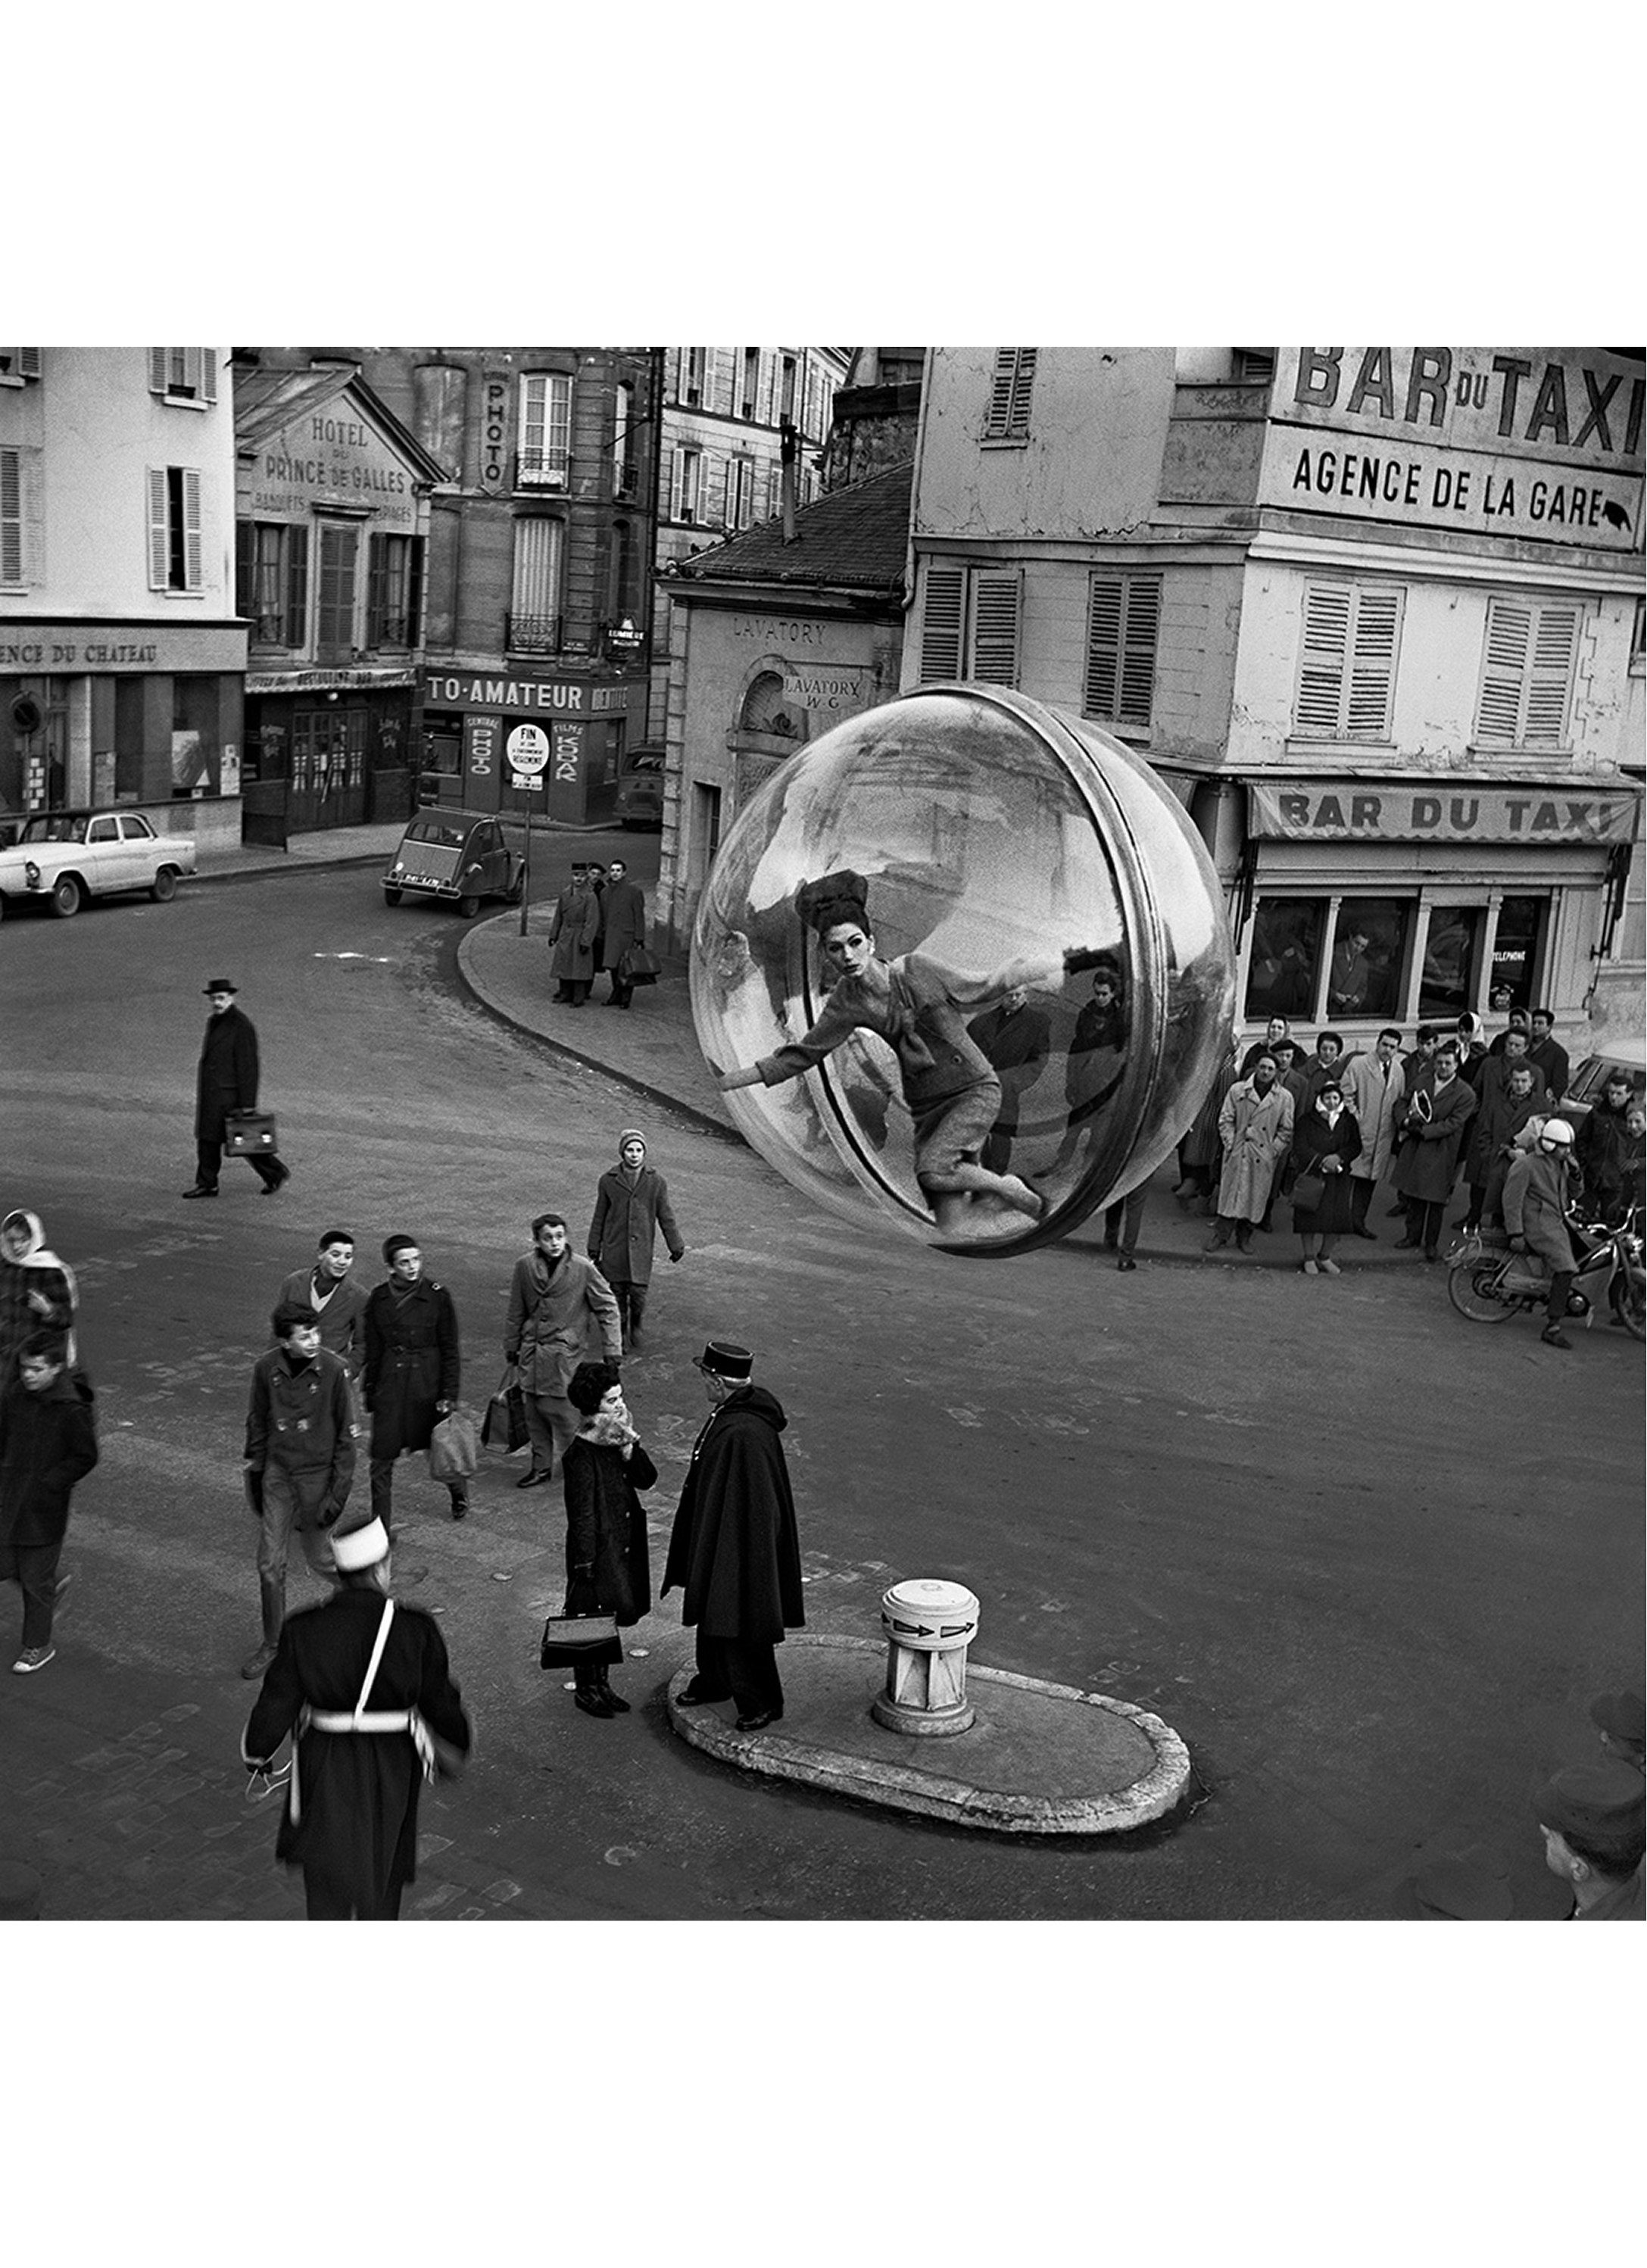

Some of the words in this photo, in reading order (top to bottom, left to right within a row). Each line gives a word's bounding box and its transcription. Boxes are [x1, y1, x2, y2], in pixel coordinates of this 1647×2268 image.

[1293, 347, 1452, 426] BAR
[1455, 370, 1489, 410] DU
[1492, 355, 1646, 455] TAXI
[312, 417, 369, 448] HOTEL
[485, 385, 504, 481] PHOTO
[266, 455, 326, 485] PRINCE
[351, 465, 405, 494] GALLES
[1292, 448, 1422, 505] AGENCE
[1432, 467, 1471, 510] DE
[1483, 476, 1515, 517] LA
[1529, 481, 1604, 527] GARE
[733, 617, 827, 644] LAVATORY
[51, 644, 76, 663] DU
[84, 644, 158, 663] CHATEAU
[785, 676, 860, 698] LAVATORY
[520, 727, 537, 740] FIN
[553, 723, 584, 735] FILMS
[470, 729, 494, 775] PHOTO
[555, 736, 580, 782] KODAK
[1279, 794, 1382, 828] BAR
[1411, 797, 1480, 831] DU
[1504, 800, 1612, 835] TAXI
